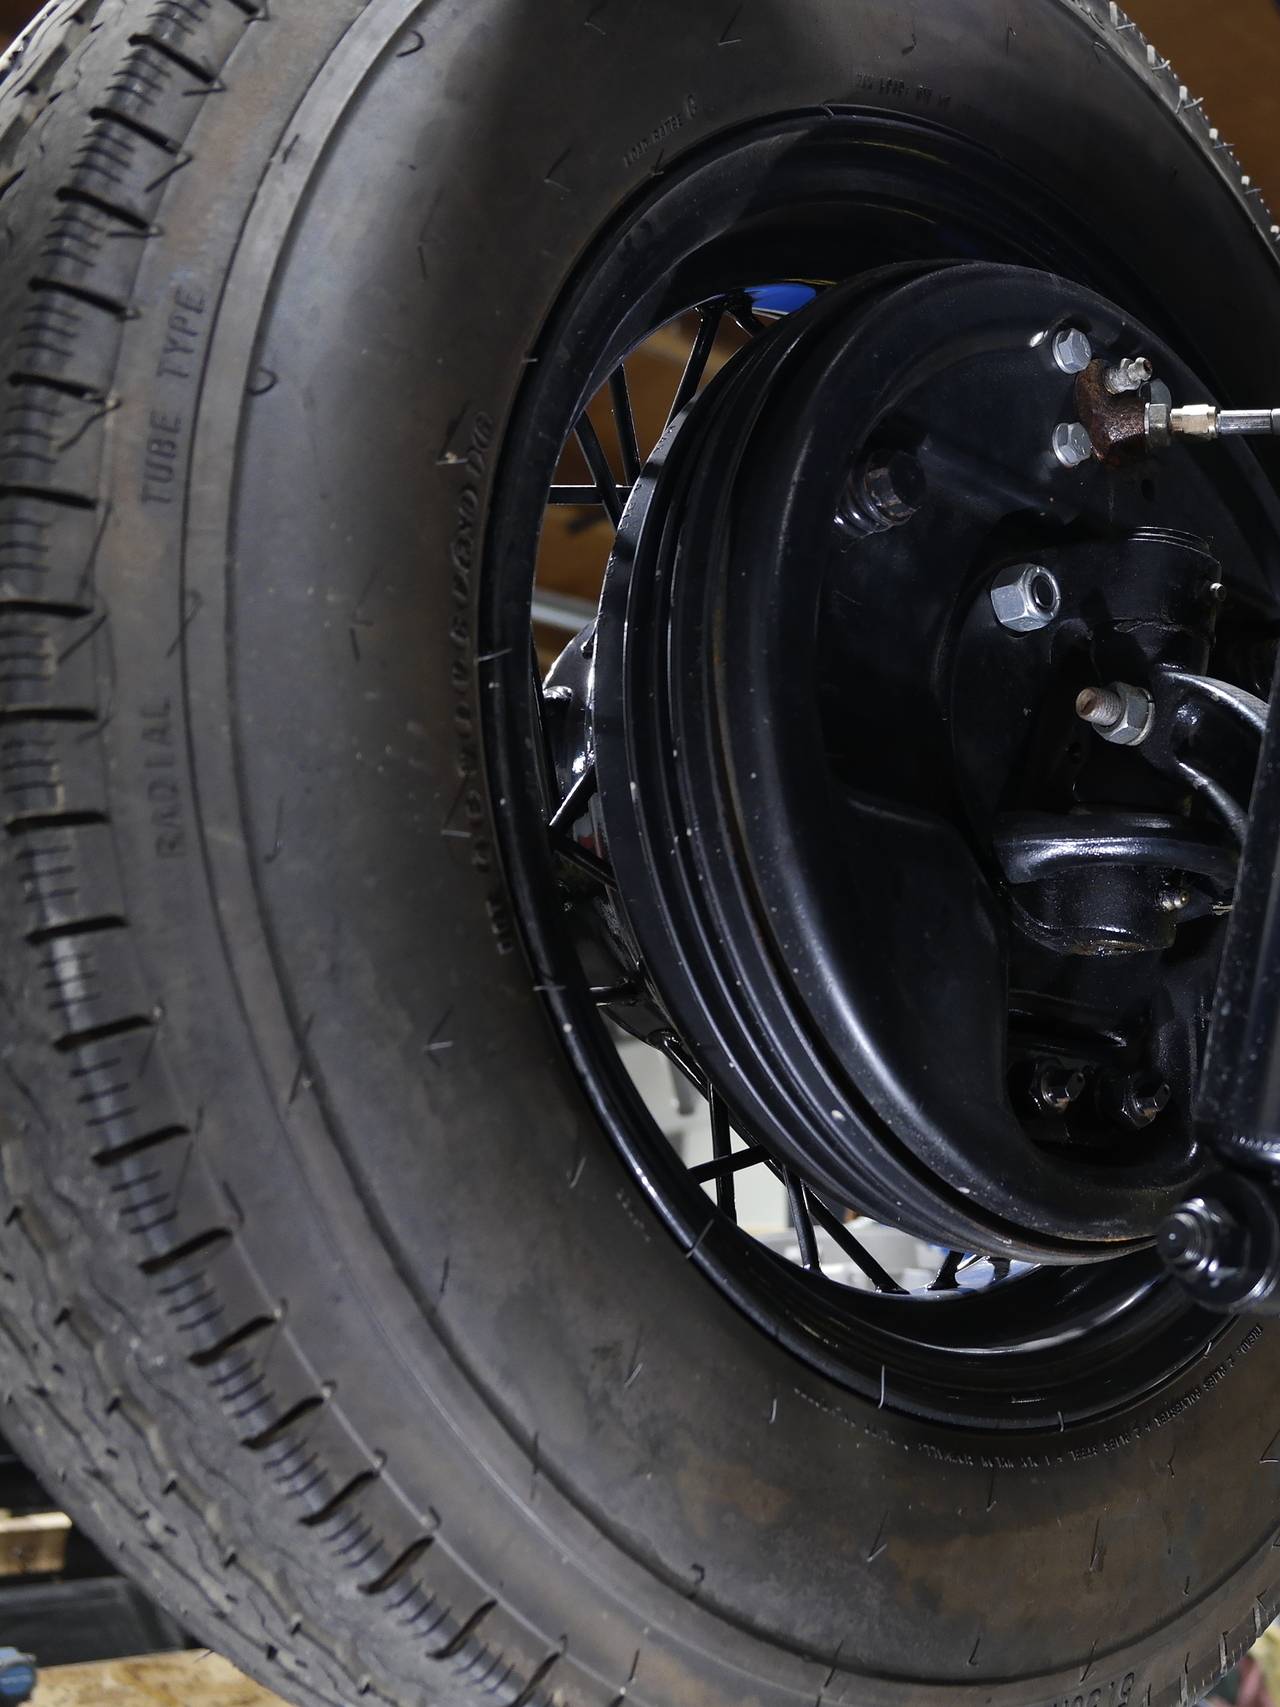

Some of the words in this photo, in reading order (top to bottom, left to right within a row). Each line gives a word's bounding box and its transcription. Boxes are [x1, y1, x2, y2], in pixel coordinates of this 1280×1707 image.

[156, 284, 206, 379] TYPE
[141, 408, 181, 506] TUBE
[141, 700, 186, 859] RADIAL
